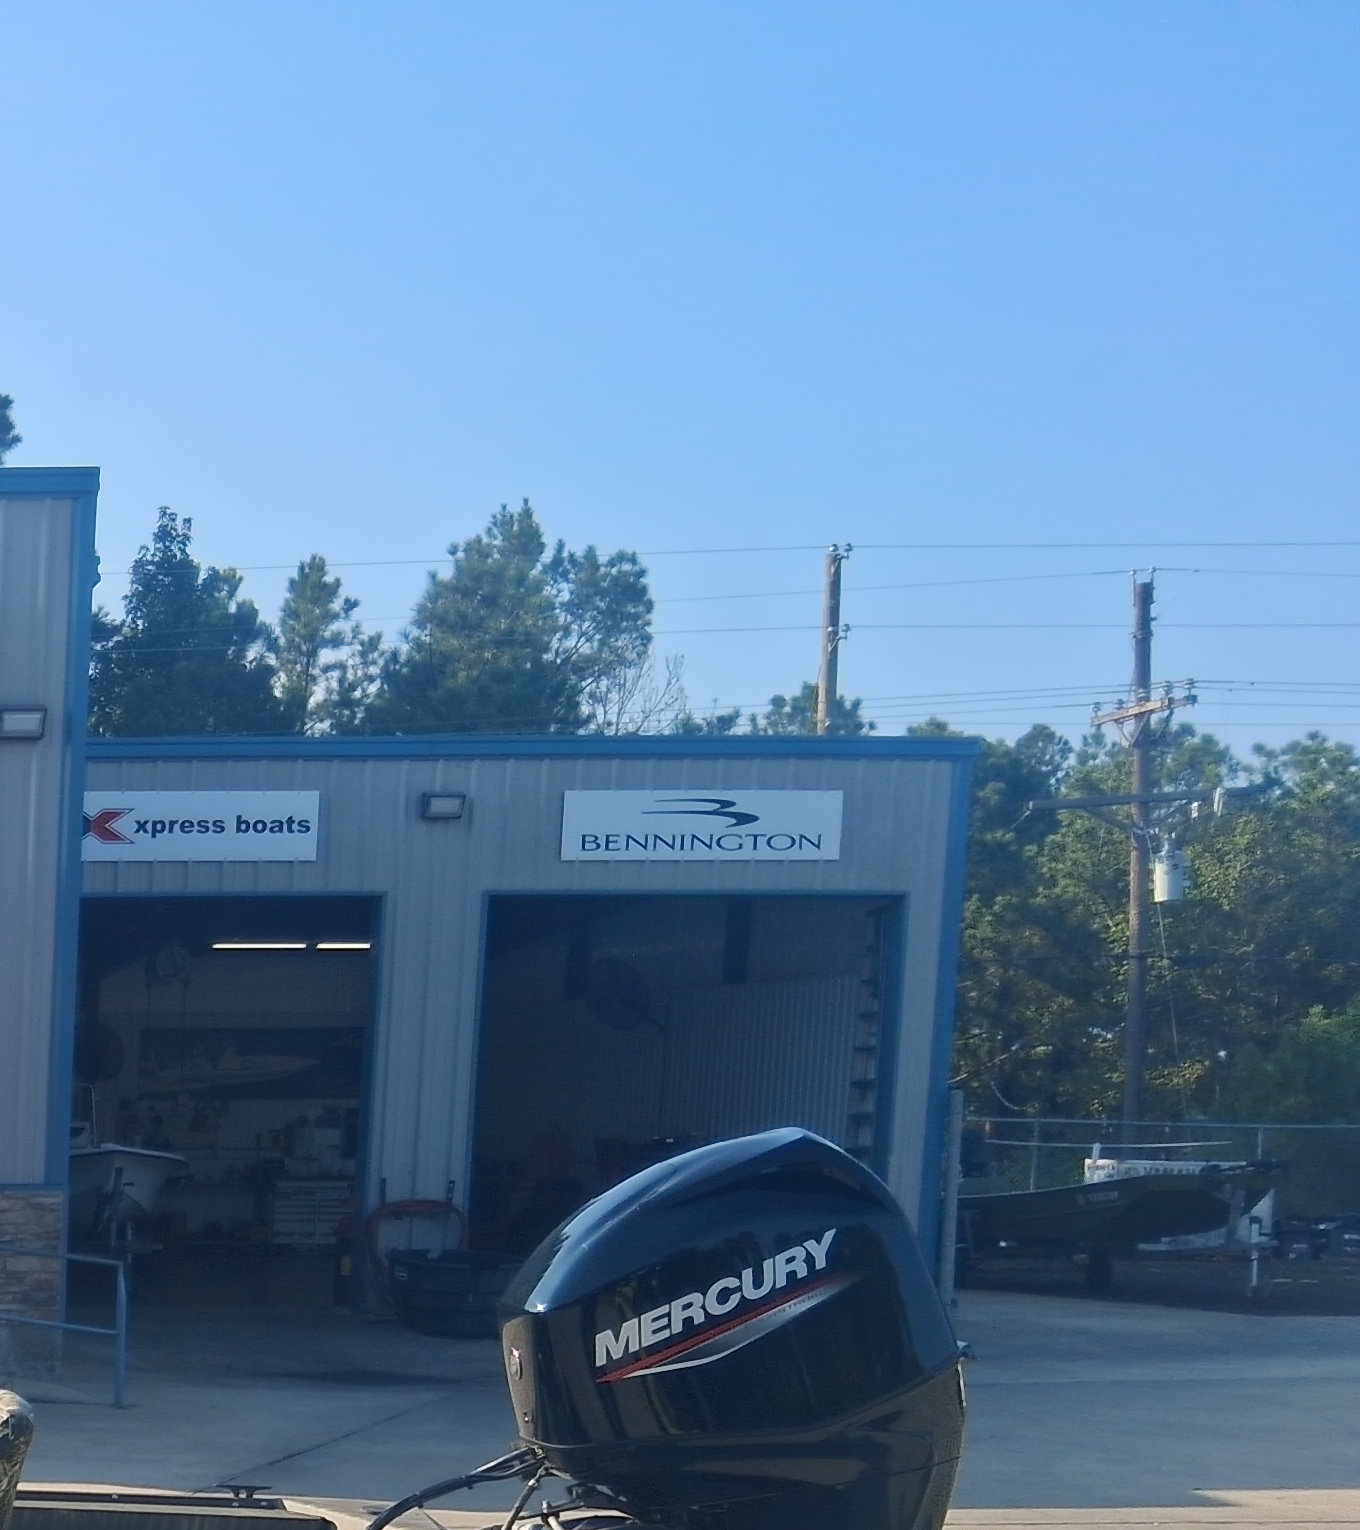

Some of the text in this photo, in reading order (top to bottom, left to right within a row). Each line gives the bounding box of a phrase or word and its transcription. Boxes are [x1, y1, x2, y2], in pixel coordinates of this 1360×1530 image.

[134, 815, 311, 838] xpress boats
[581, 833, 822, 851] BENNINGTON
[595, 1228, 837, 1367] MERCURY
